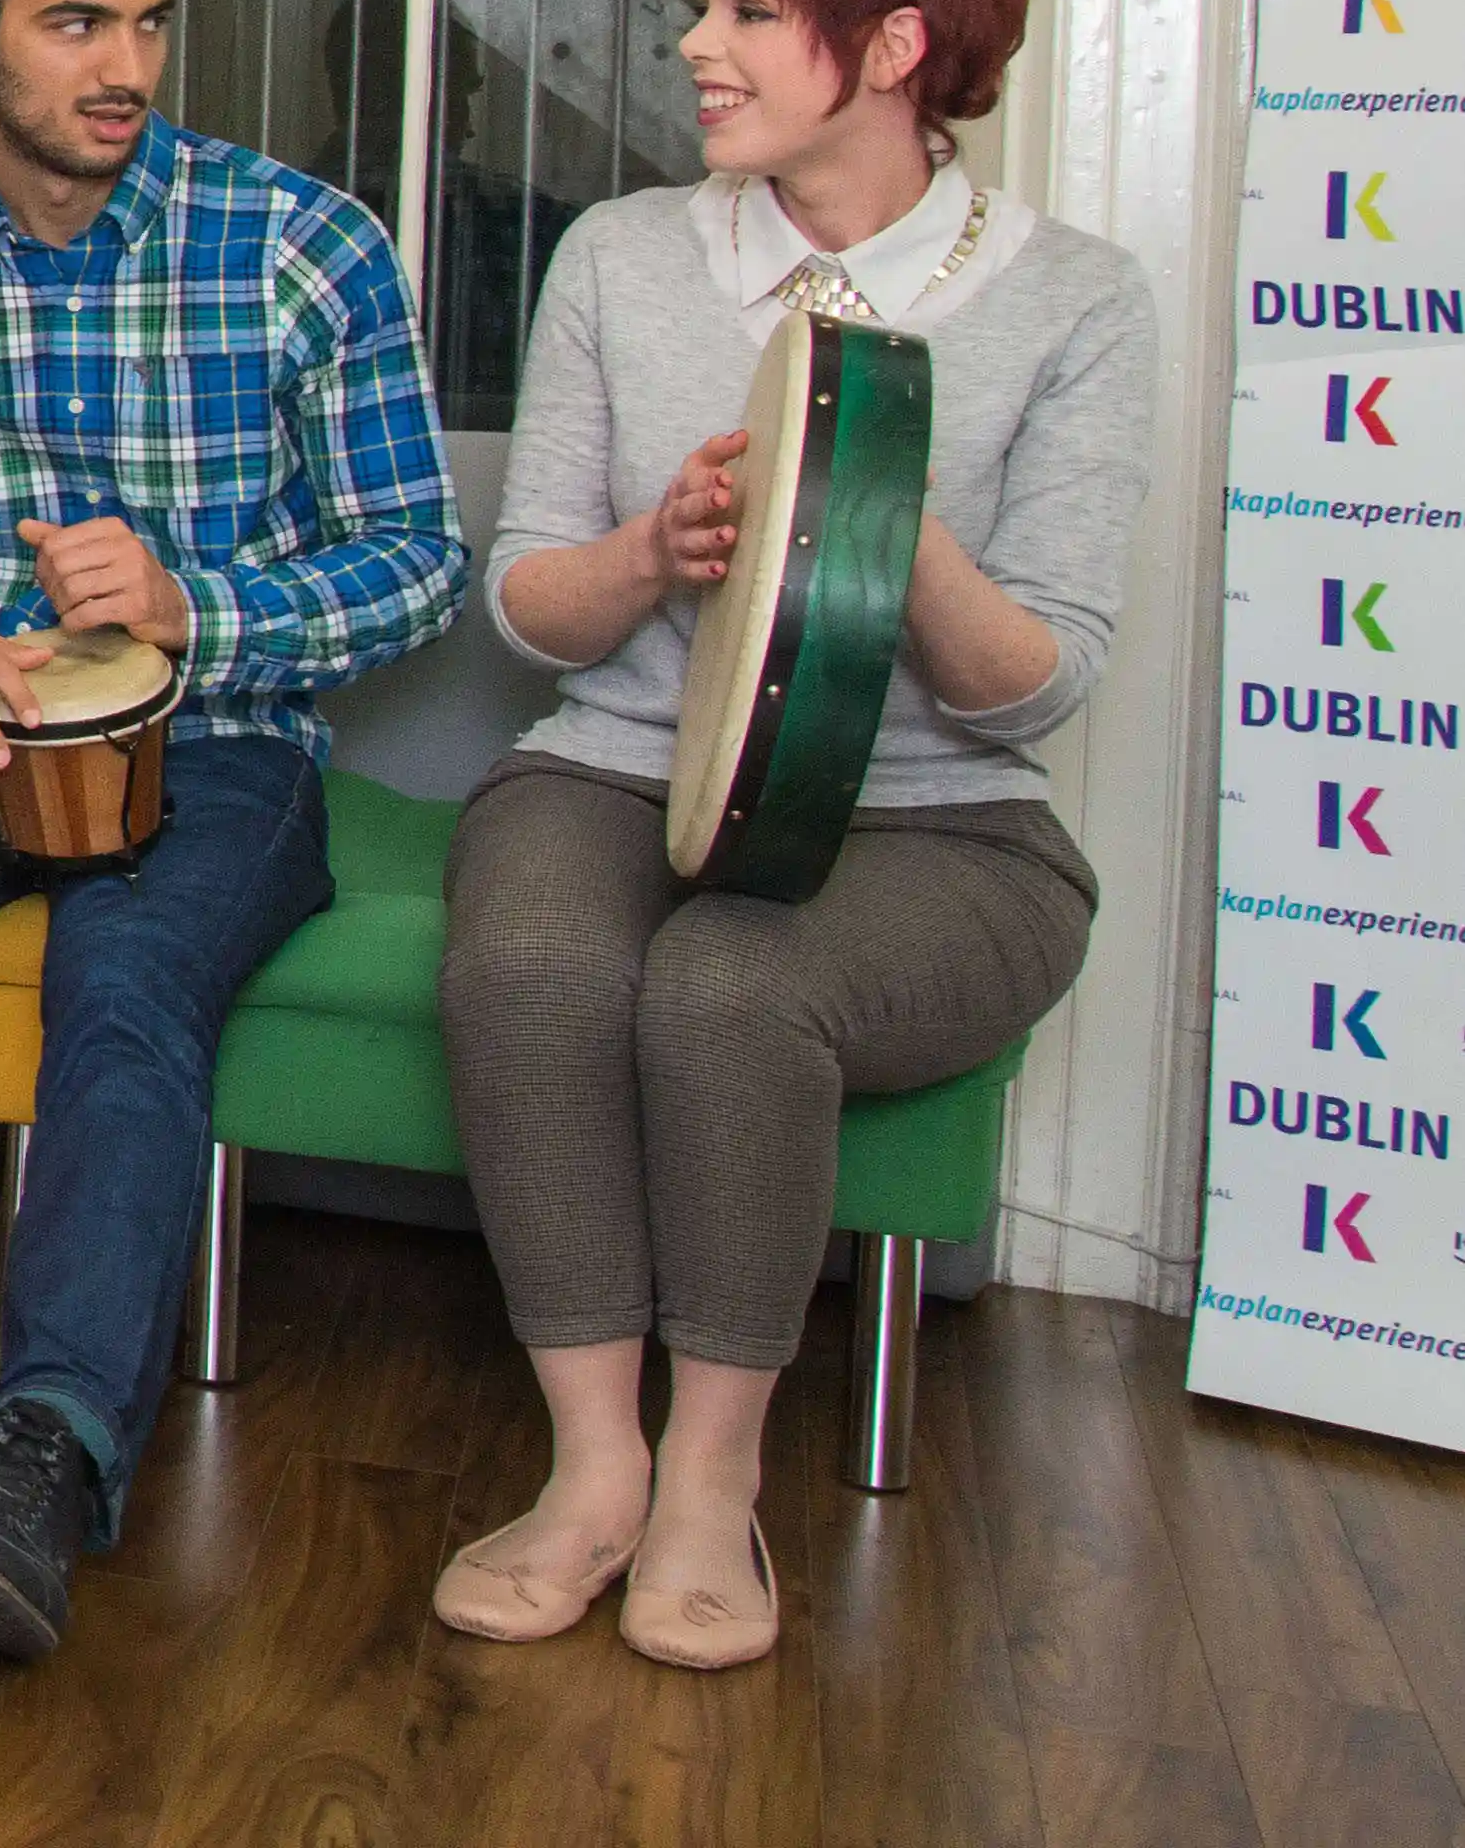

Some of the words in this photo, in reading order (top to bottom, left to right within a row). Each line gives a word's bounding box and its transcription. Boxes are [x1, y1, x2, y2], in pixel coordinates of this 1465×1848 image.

[1325, 170, 1397, 242] K
[1252, 281, 1464, 335] DUBLIN
[1324, 373, 1399, 446] K
[1320, 577, 1396, 653] K
[1240, 681, 1459, 750] DUBLIN
[1317, 780, 1393, 857] K
[1311, 981, 1388, 1060] K
[1228, 1080, 1450, 1160] DUBLIN
[1302, 1183, 1377, 1264] K
